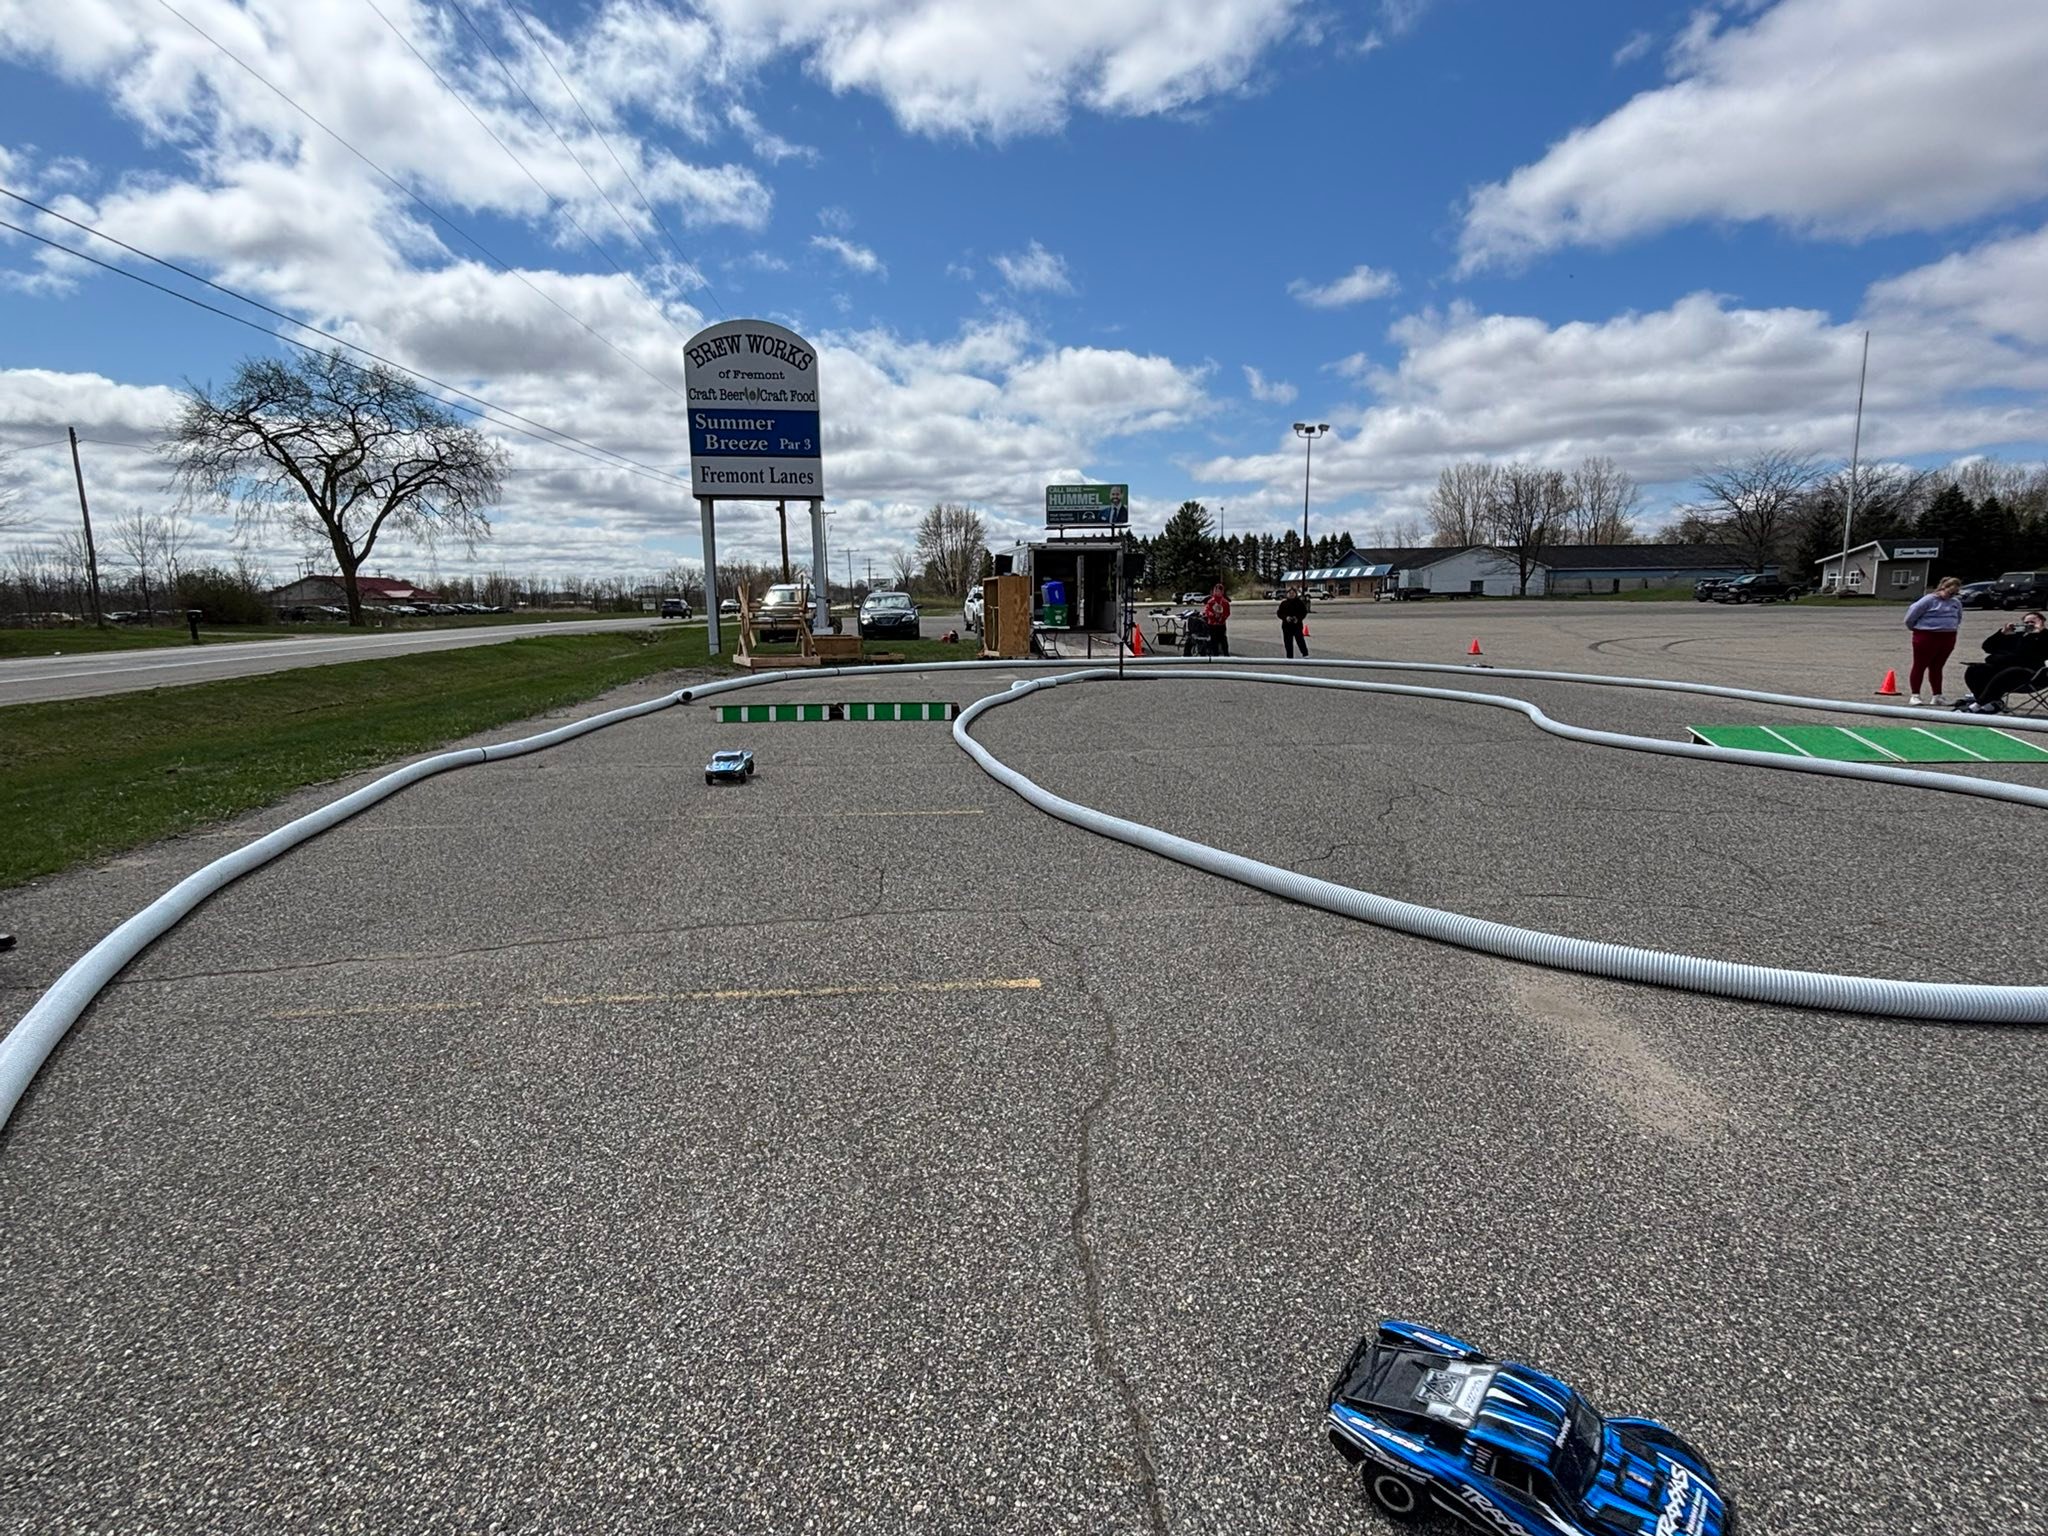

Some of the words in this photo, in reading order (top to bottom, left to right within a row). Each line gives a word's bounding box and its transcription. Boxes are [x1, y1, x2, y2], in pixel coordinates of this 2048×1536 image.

[686, 334, 742, 369] BREW
[745, 333, 814, 372] WORKS
[718, 369, 732, 379] of
[733, 369, 785, 380] Fremont
[688, 388, 717, 400] Craft
[719, 388, 745, 401] Beer
[760, 389, 790, 402] Craft
[791, 390, 816, 403] Food
[695, 413, 775, 431] Summer
[705, 434, 769, 451] Breeze
[779, 438, 801, 450] Par
[804, 438, 812, 450] 3
[700, 466, 765, 484] Fremont
[769, 467, 814, 485] Lanes
[1049, 493, 1103, 505] HUMMEL
